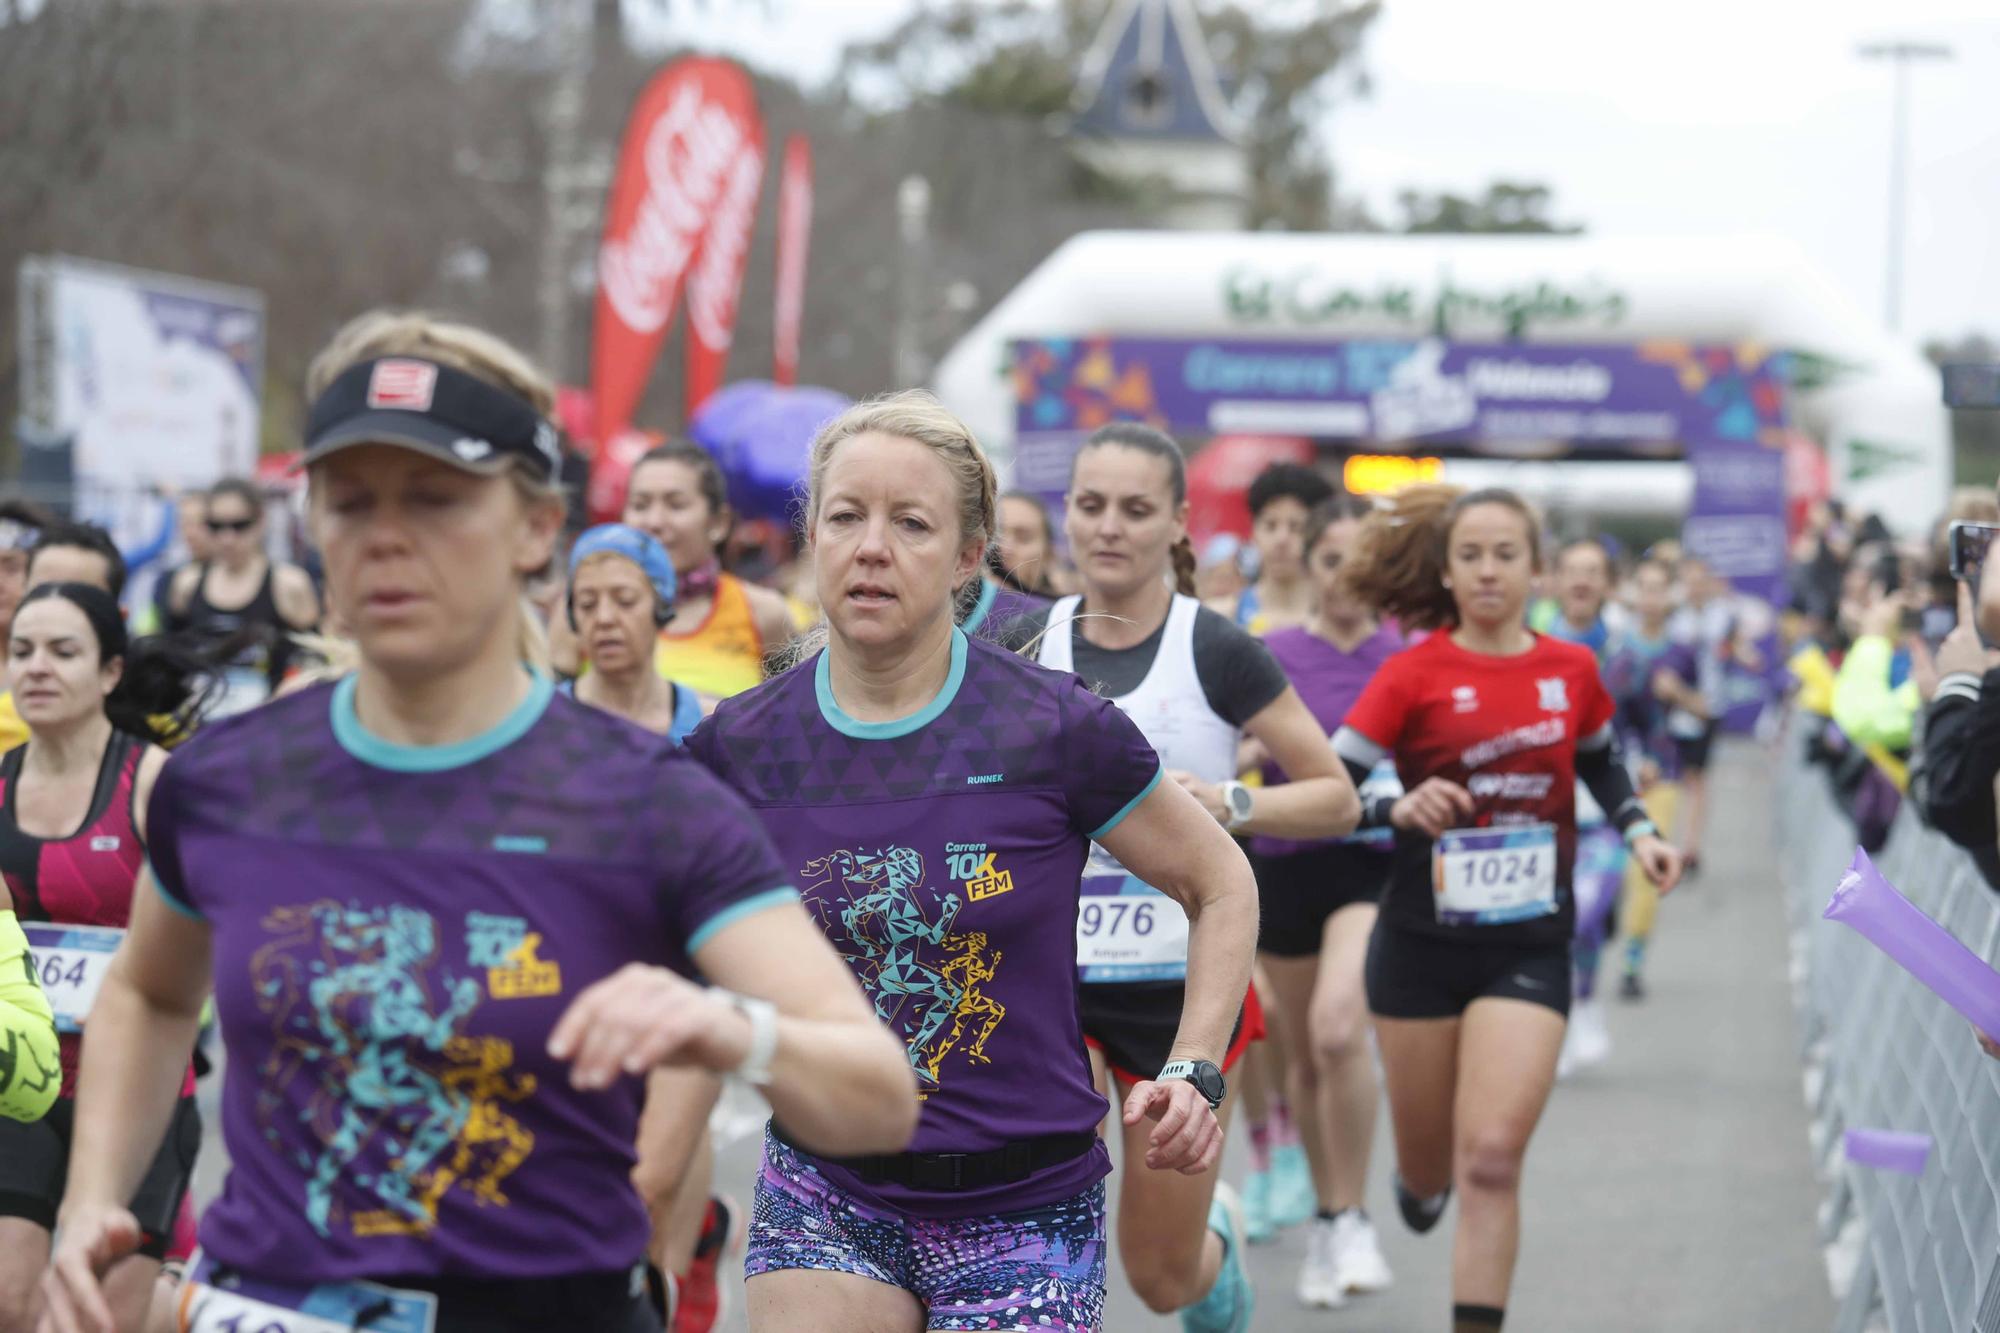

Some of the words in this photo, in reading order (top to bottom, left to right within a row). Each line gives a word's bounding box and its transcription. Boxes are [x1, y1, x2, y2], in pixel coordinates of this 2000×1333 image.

[967, 773, 1004, 785] RUNNEK
[945, 842, 987, 853] Carrera
[945, 852, 997, 880] 10K
[1462, 854, 1539, 889] 1024
[971, 873, 1008, 899] FEM
[1082, 903, 1155, 936] 976
[32, 955, 87, 988] 64
